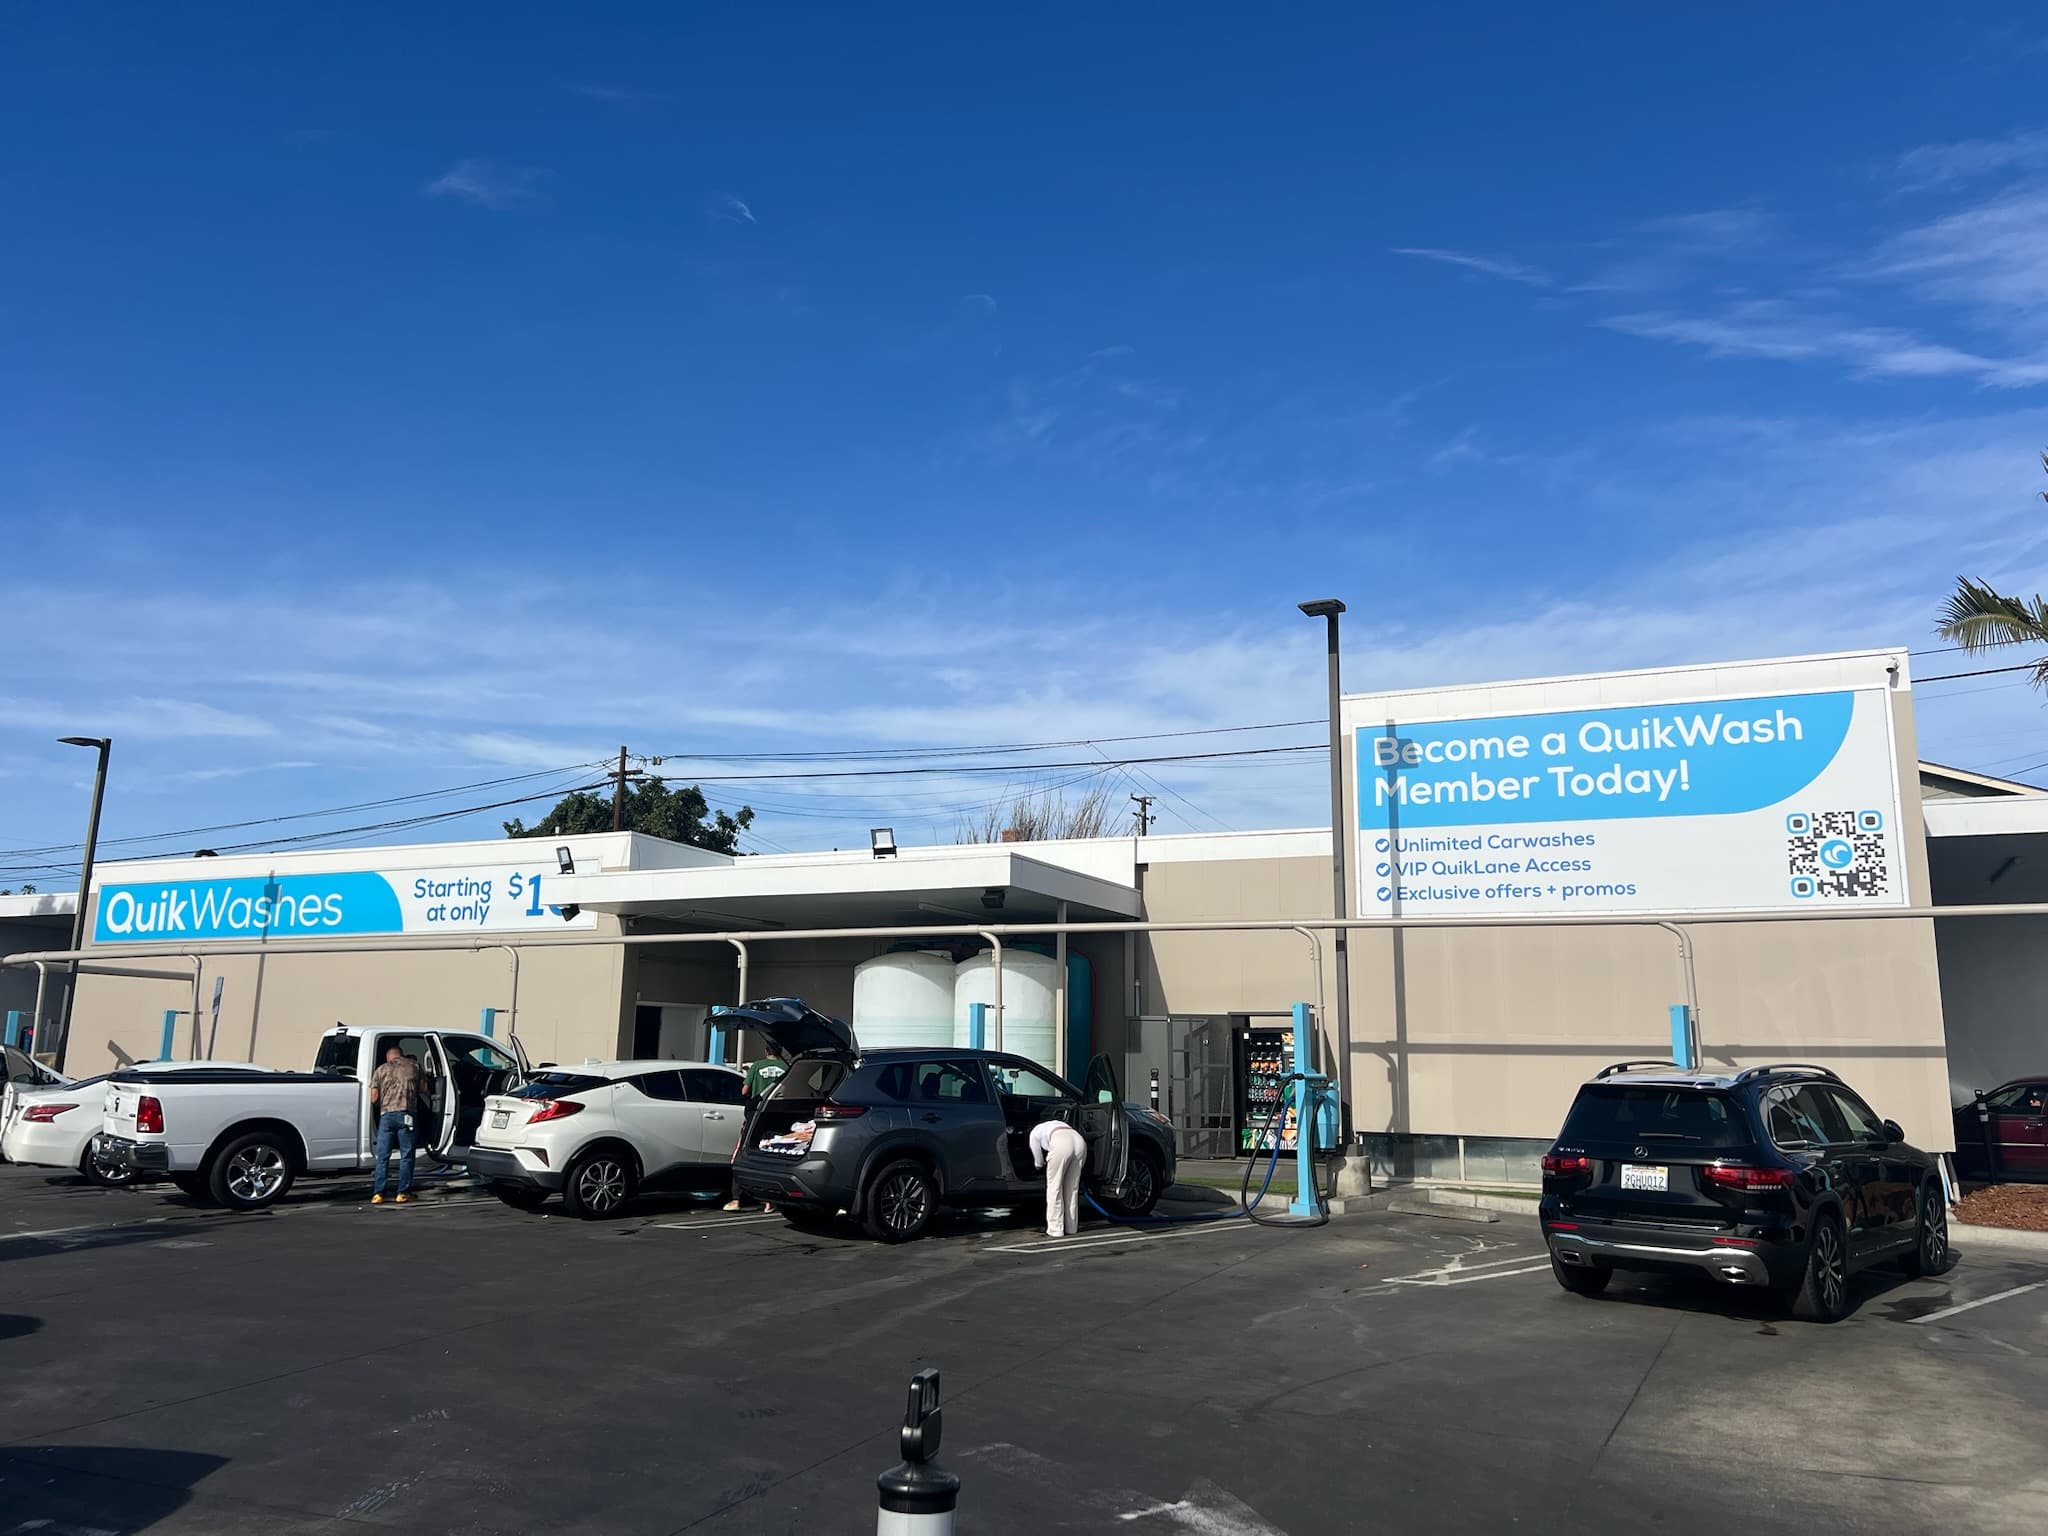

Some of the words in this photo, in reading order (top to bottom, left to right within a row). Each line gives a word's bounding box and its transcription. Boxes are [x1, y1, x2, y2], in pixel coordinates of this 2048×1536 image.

[1373, 734, 1530, 766] Become
[1540, 731, 1567, 756] a
[1578, 709, 1803, 753] QuikWash
[1375, 775, 1541, 807] Member
[1547, 759, 1690, 802] Today!
[1394, 836, 1482, 853] Unlimited
[1487, 832, 1595, 850] Carwashes
[1395, 862, 1428, 877] VIP
[1431, 860, 1521, 876] QuikLane
[1525, 858, 1592, 873] Access
[414, 877, 492, 903] Starting
[1397, 885, 1481, 901] Exclusive
[1485, 884, 1542, 899] offers
[1546, 886, 1557, 897] +
[1562, 882, 1637, 901] promos
[427, 904, 446, 922] at
[450, 900, 490, 926] only
